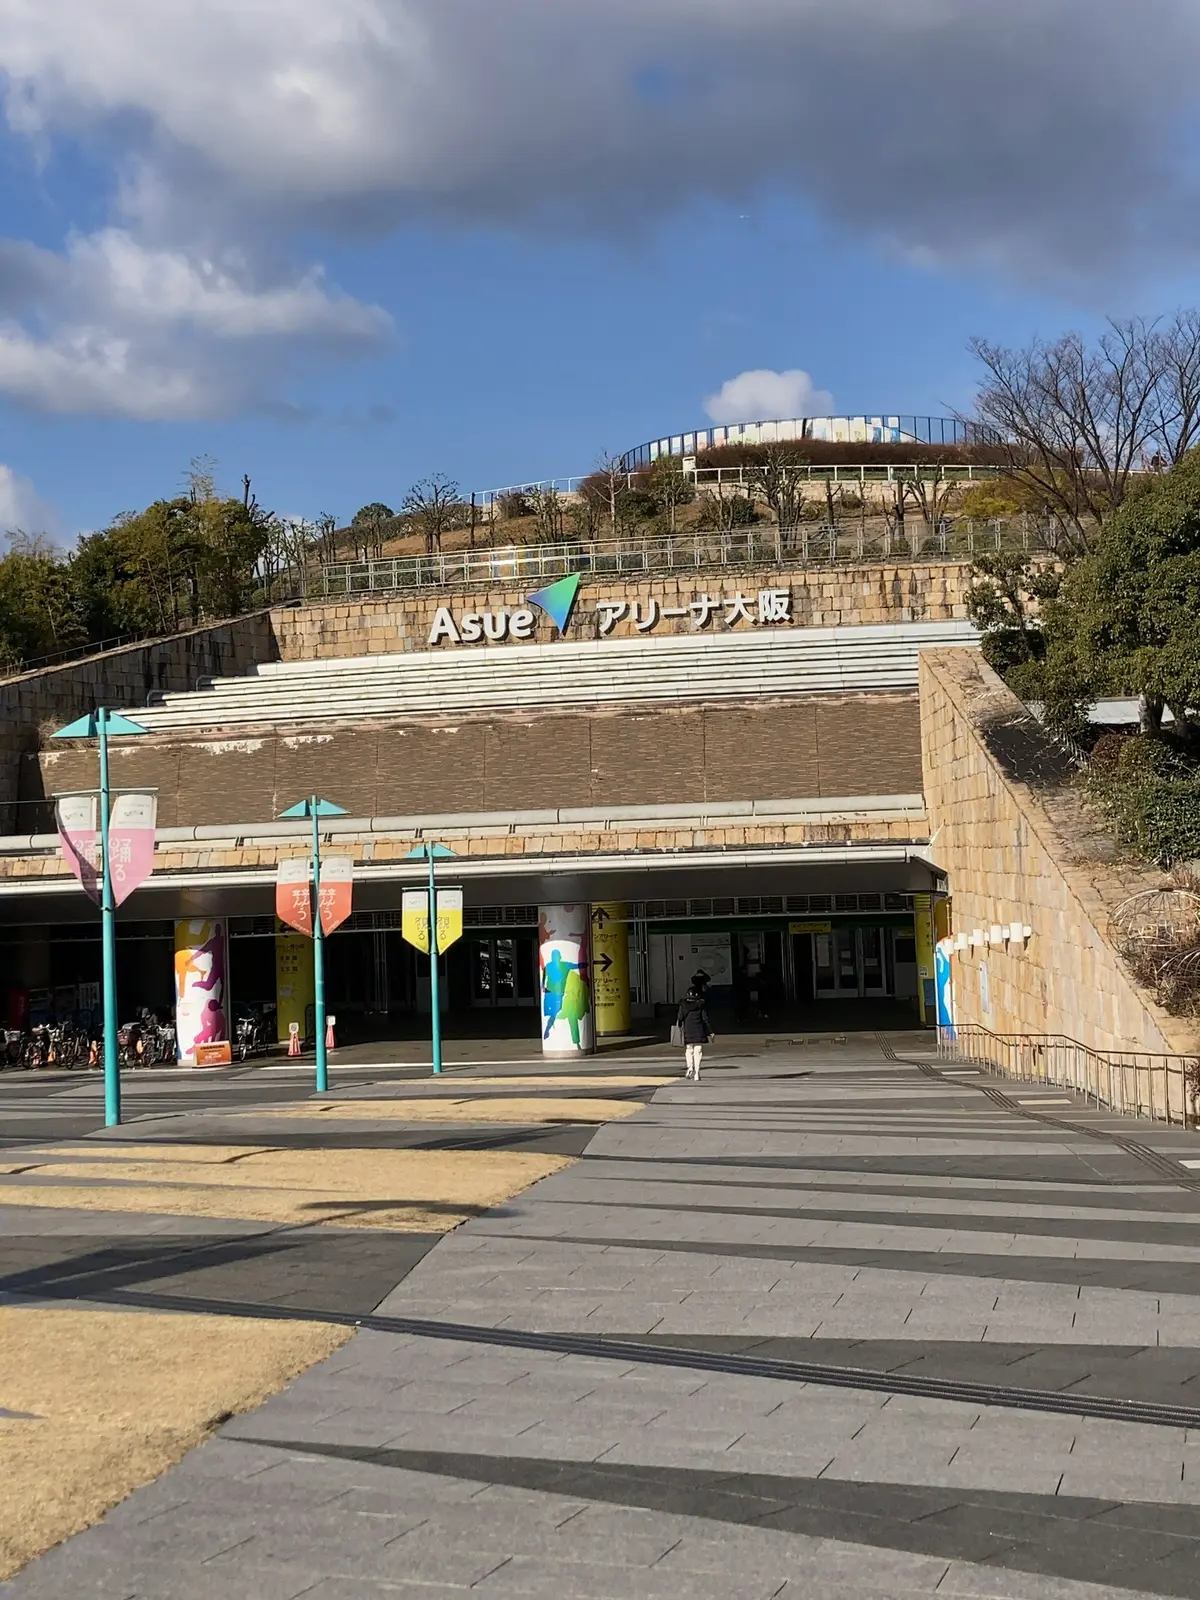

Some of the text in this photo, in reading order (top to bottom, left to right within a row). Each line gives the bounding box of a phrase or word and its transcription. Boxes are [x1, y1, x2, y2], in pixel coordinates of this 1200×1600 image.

[428, 589, 792, 644] Asue アリーナ大阪
